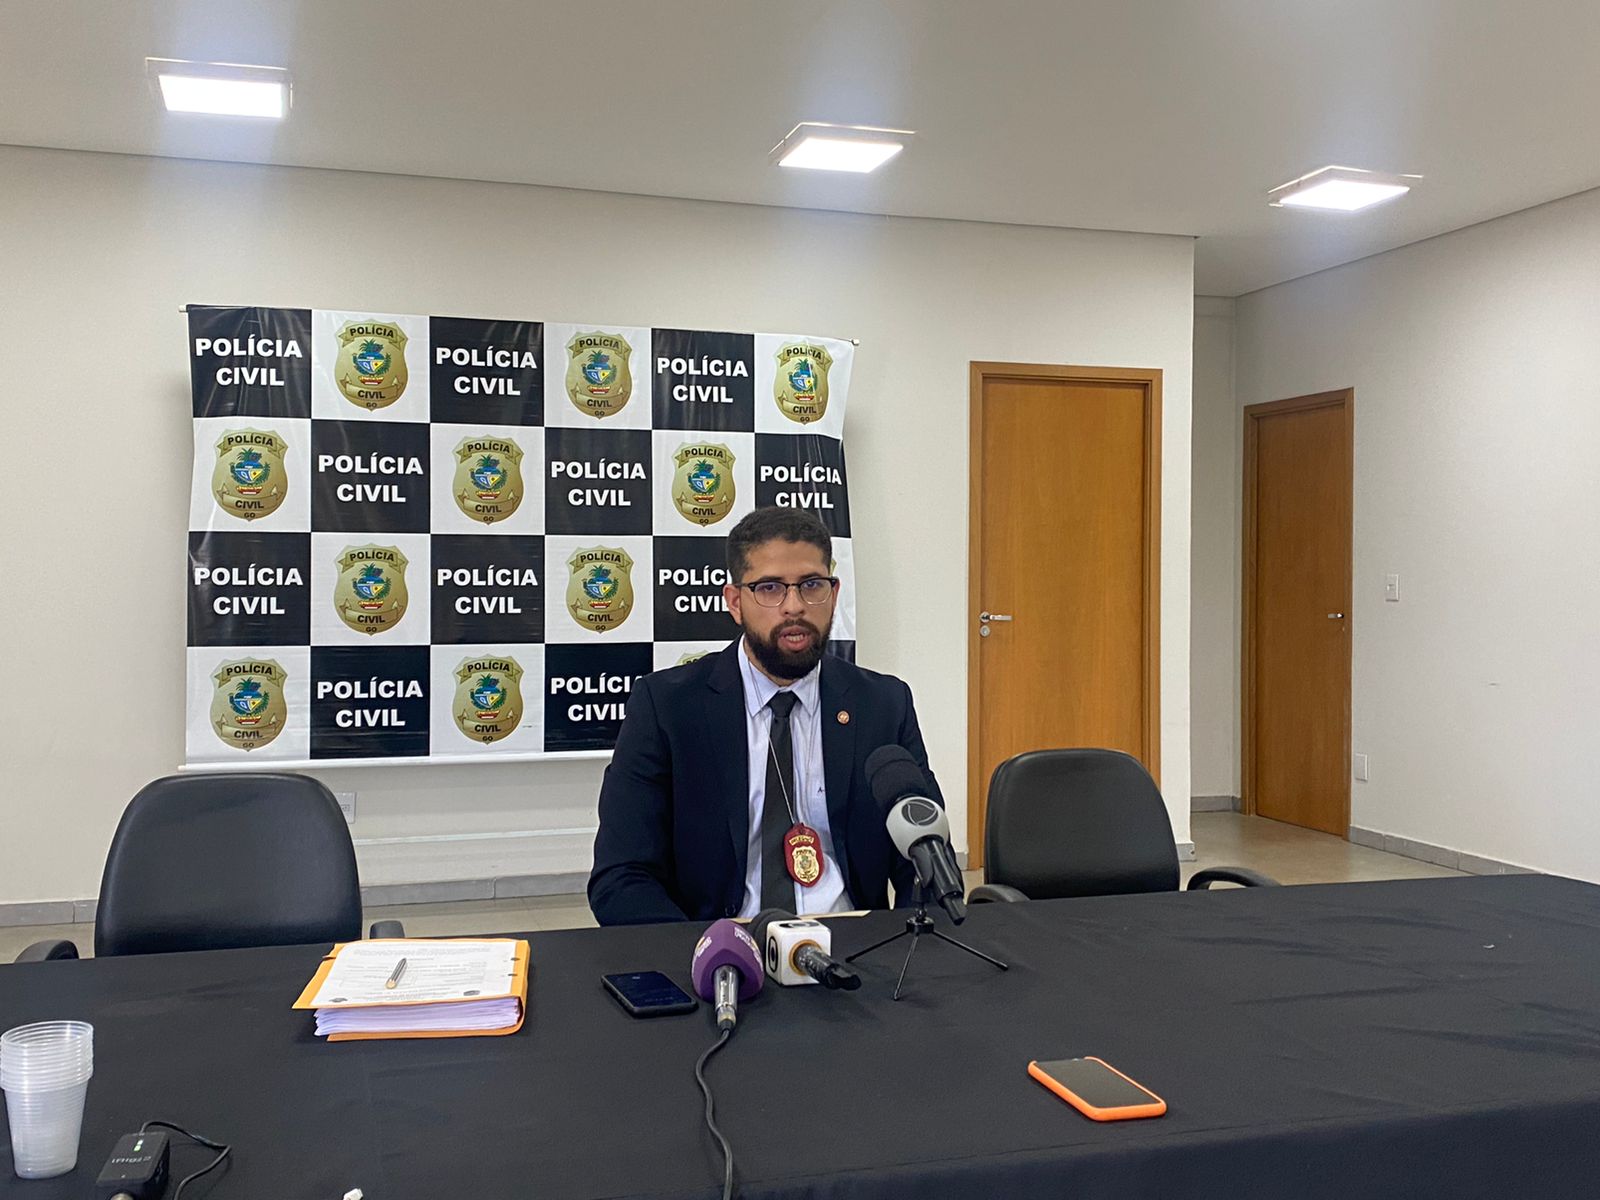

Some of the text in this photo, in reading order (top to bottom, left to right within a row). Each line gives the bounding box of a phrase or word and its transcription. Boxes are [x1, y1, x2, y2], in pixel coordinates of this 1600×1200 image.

[349, 325, 394, 338] POLÍCIA
[196, 334, 302, 357] POLÍCIA
[578, 336, 620, 349] POLÍCIA
[437, 346, 537, 368] POLÍCIA
[658, 356, 748, 377] POLÍCIA
[217, 367, 284, 385] CIVIL
[454, 377, 520, 395] CIVIL
[673, 385, 733, 402] CIVIL
[357, 389, 386, 399] CIVIL
[586, 398, 613, 408] CIVIL
[792, 405, 817, 414] CIVIL
[227, 432, 274, 446] POLÍCIA
[467, 441, 511, 454] POLÍCIA
[684, 446, 724, 458] POLÍCIA
[319, 452, 423, 474] POLÍCIA
[552, 459, 646, 479] POLÍCIA
[761, 463, 842, 485] POLÍCIA
[337, 484, 406, 502] CIVIL
[569, 489, 630, 505] CIVIL
[776, 493, 833, 508] CIVIL
[235, 499, 264, 510] CIVIL
[475, 504, 502, 513] CIVIL
[692, 507, 717, 516] CIVIL
[349, 550, 395, 562] POLÍCIA
[580, 551, 622, 563] POLÍCIA
[193, 563, 303, 585] POLÍCIA
[438, 565, 538, 585] POLÍCIA
[659, 565, 733, 586] POLÍCI
[214, 597, 285, 614] CIVIL
[455, 597, 521, 614] CIVIL
[357, 614, 386, 624] CIVIL
[587, 613, 614, 622] CIVIL
[226, 663, 273, 676] POLÍCIA
[467, 660, 510, 672] POLÍCIA
[318, 677, 423, 699] POLÍCIA
[551, 673, 642, 694] POLÍCI
[336, 709, 405, 727] CIVIL
[234, 730, 263, 738] CIVIL
[474, 724, 501, 733] CIVIL
